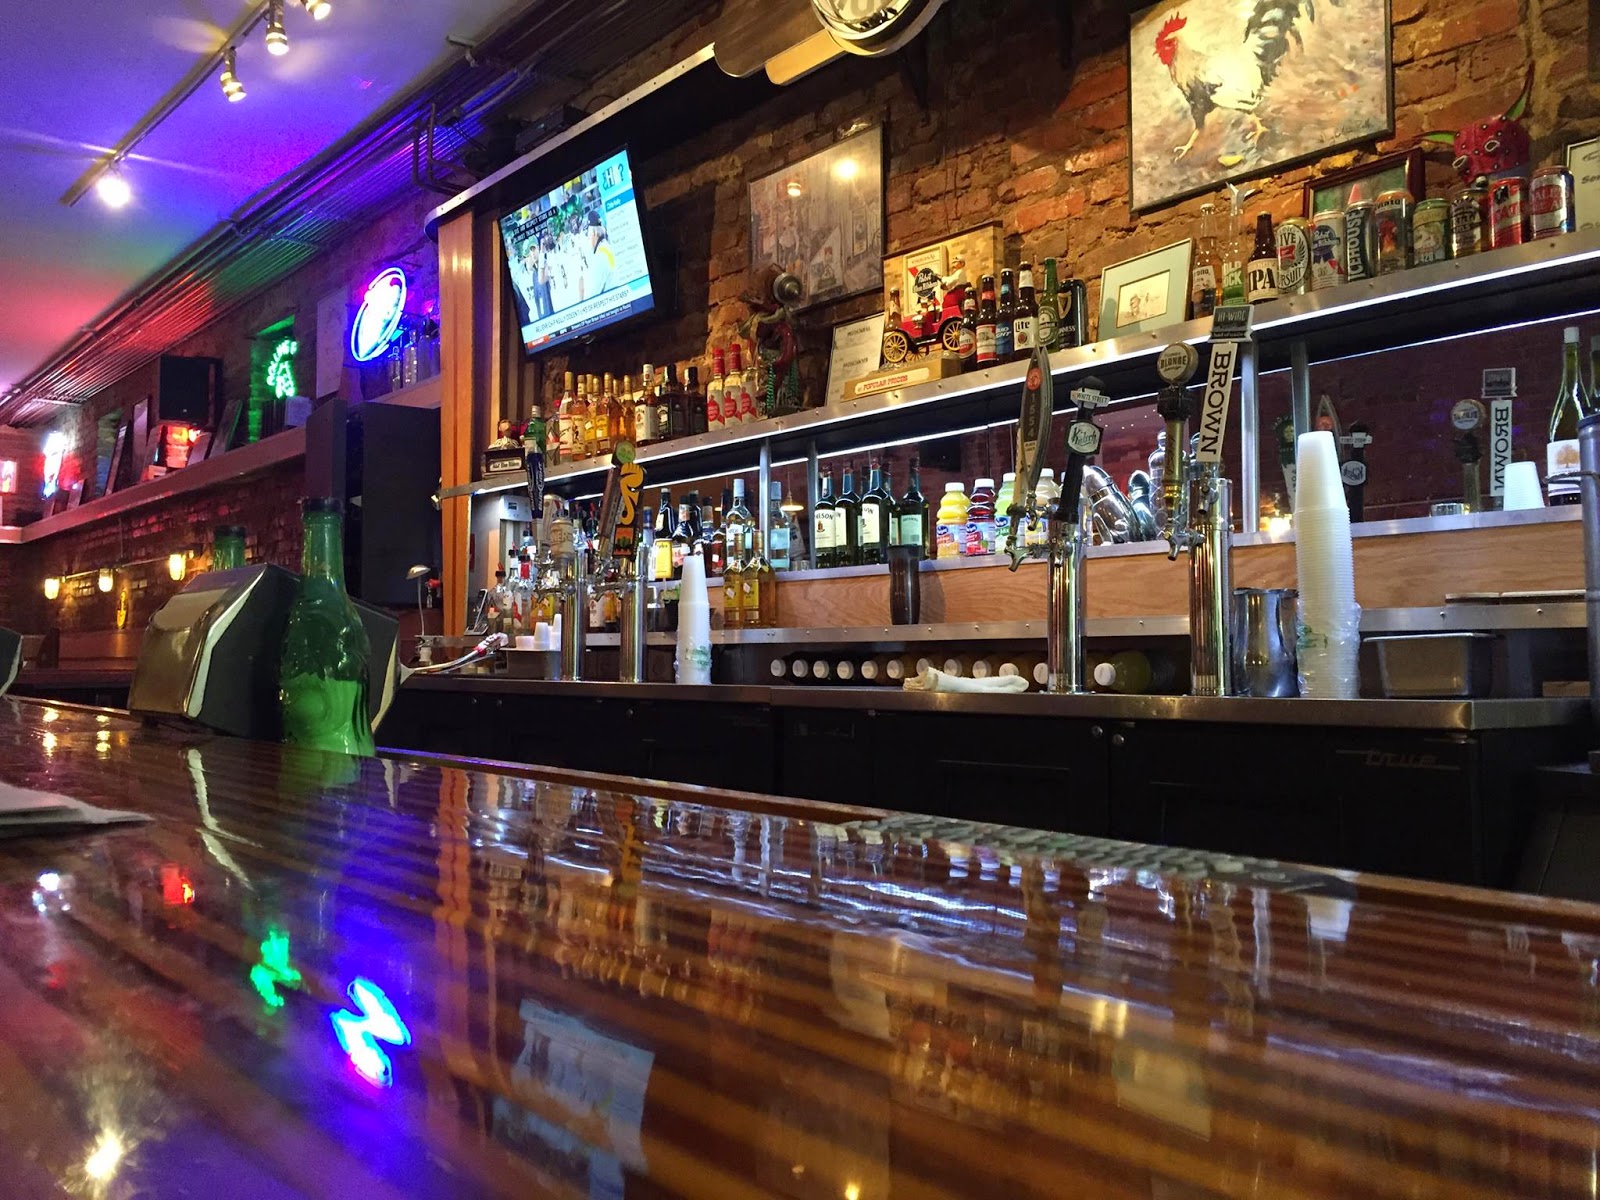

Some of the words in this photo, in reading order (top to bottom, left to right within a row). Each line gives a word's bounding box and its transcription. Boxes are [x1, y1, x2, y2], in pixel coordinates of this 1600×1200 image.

[1346, 208, 1368, 282] ICEHOUSE
[1249, 267, 1276, 291] IPA
[1281, 268, 1302, 287] RSUIT
[1015, 320, 1030, 333] Lite
[1200, 351, 1232, 455] BROWN
